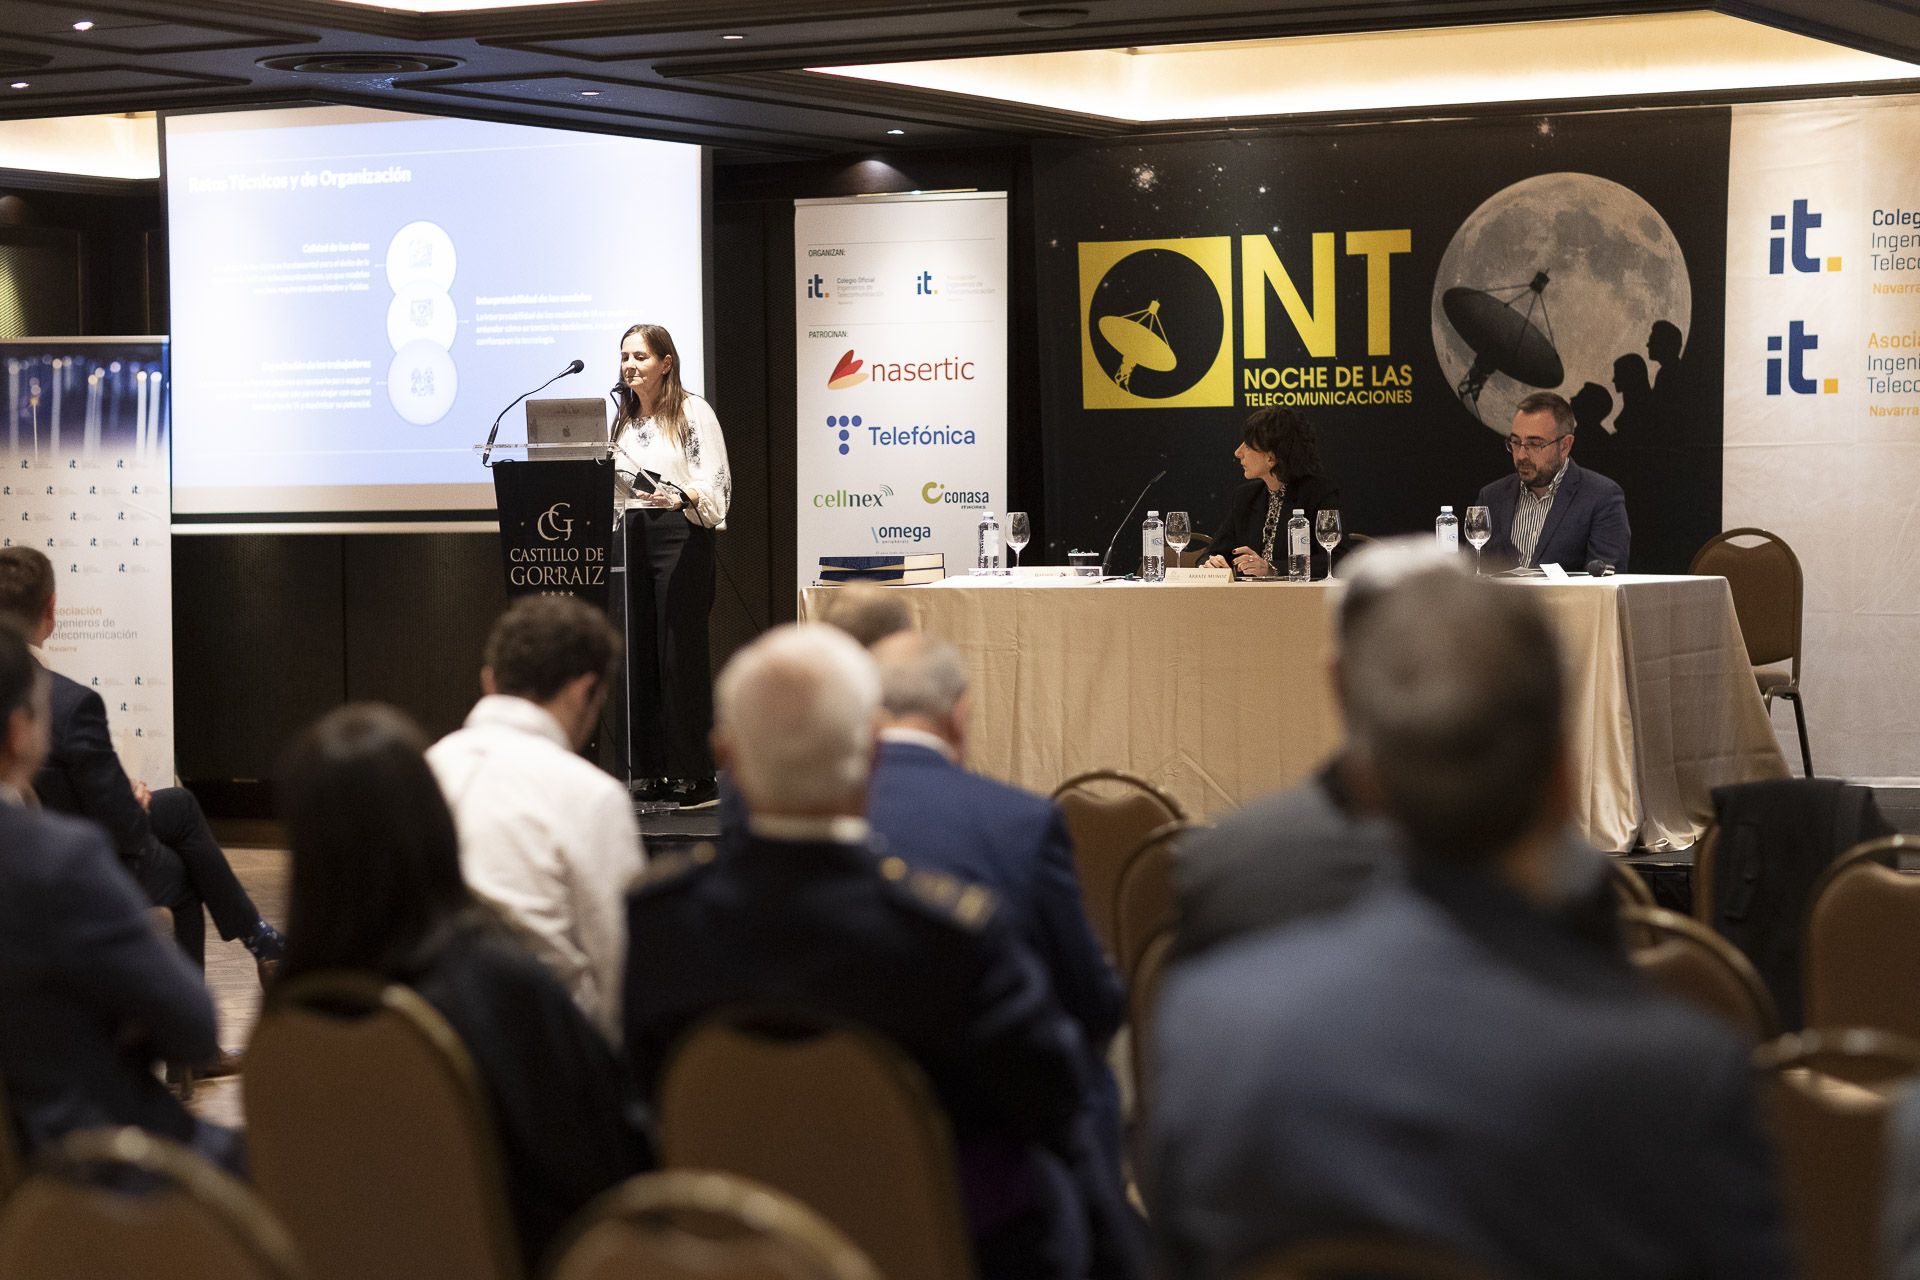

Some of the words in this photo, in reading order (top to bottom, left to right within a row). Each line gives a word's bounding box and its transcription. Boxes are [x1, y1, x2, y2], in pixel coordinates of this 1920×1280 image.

[228, 173, 288, 190] Técnicos
[290, 174, 299, 190] y
[301, 170, 318, 187] de
[320, 166, 411, 188] Organización
[1870, 254, 1920, 271] Telec
[1868, 330, 1920, 349] Asoci
[872, 357, 975, 381] nasertic
[1244, 366, 1328, 390] NOCHE
[1336, 366, 1364, 388] DE
[1372, 364, 1413, 387] LAS
[1244, 390, 1413, 407] TELECOMUNICACIONES
[1870, 404, 1919, 417] Navarra
[868, 425, 976, 446] Telefónica
[814, 490, 883, 507] cellnex
[944, 491, 989, 503] conasa
[510, 548, 579, 562] CASTILLO
[585, 548, 604, 562] DE
[510, 566, 604, 586] GORRAIZ
